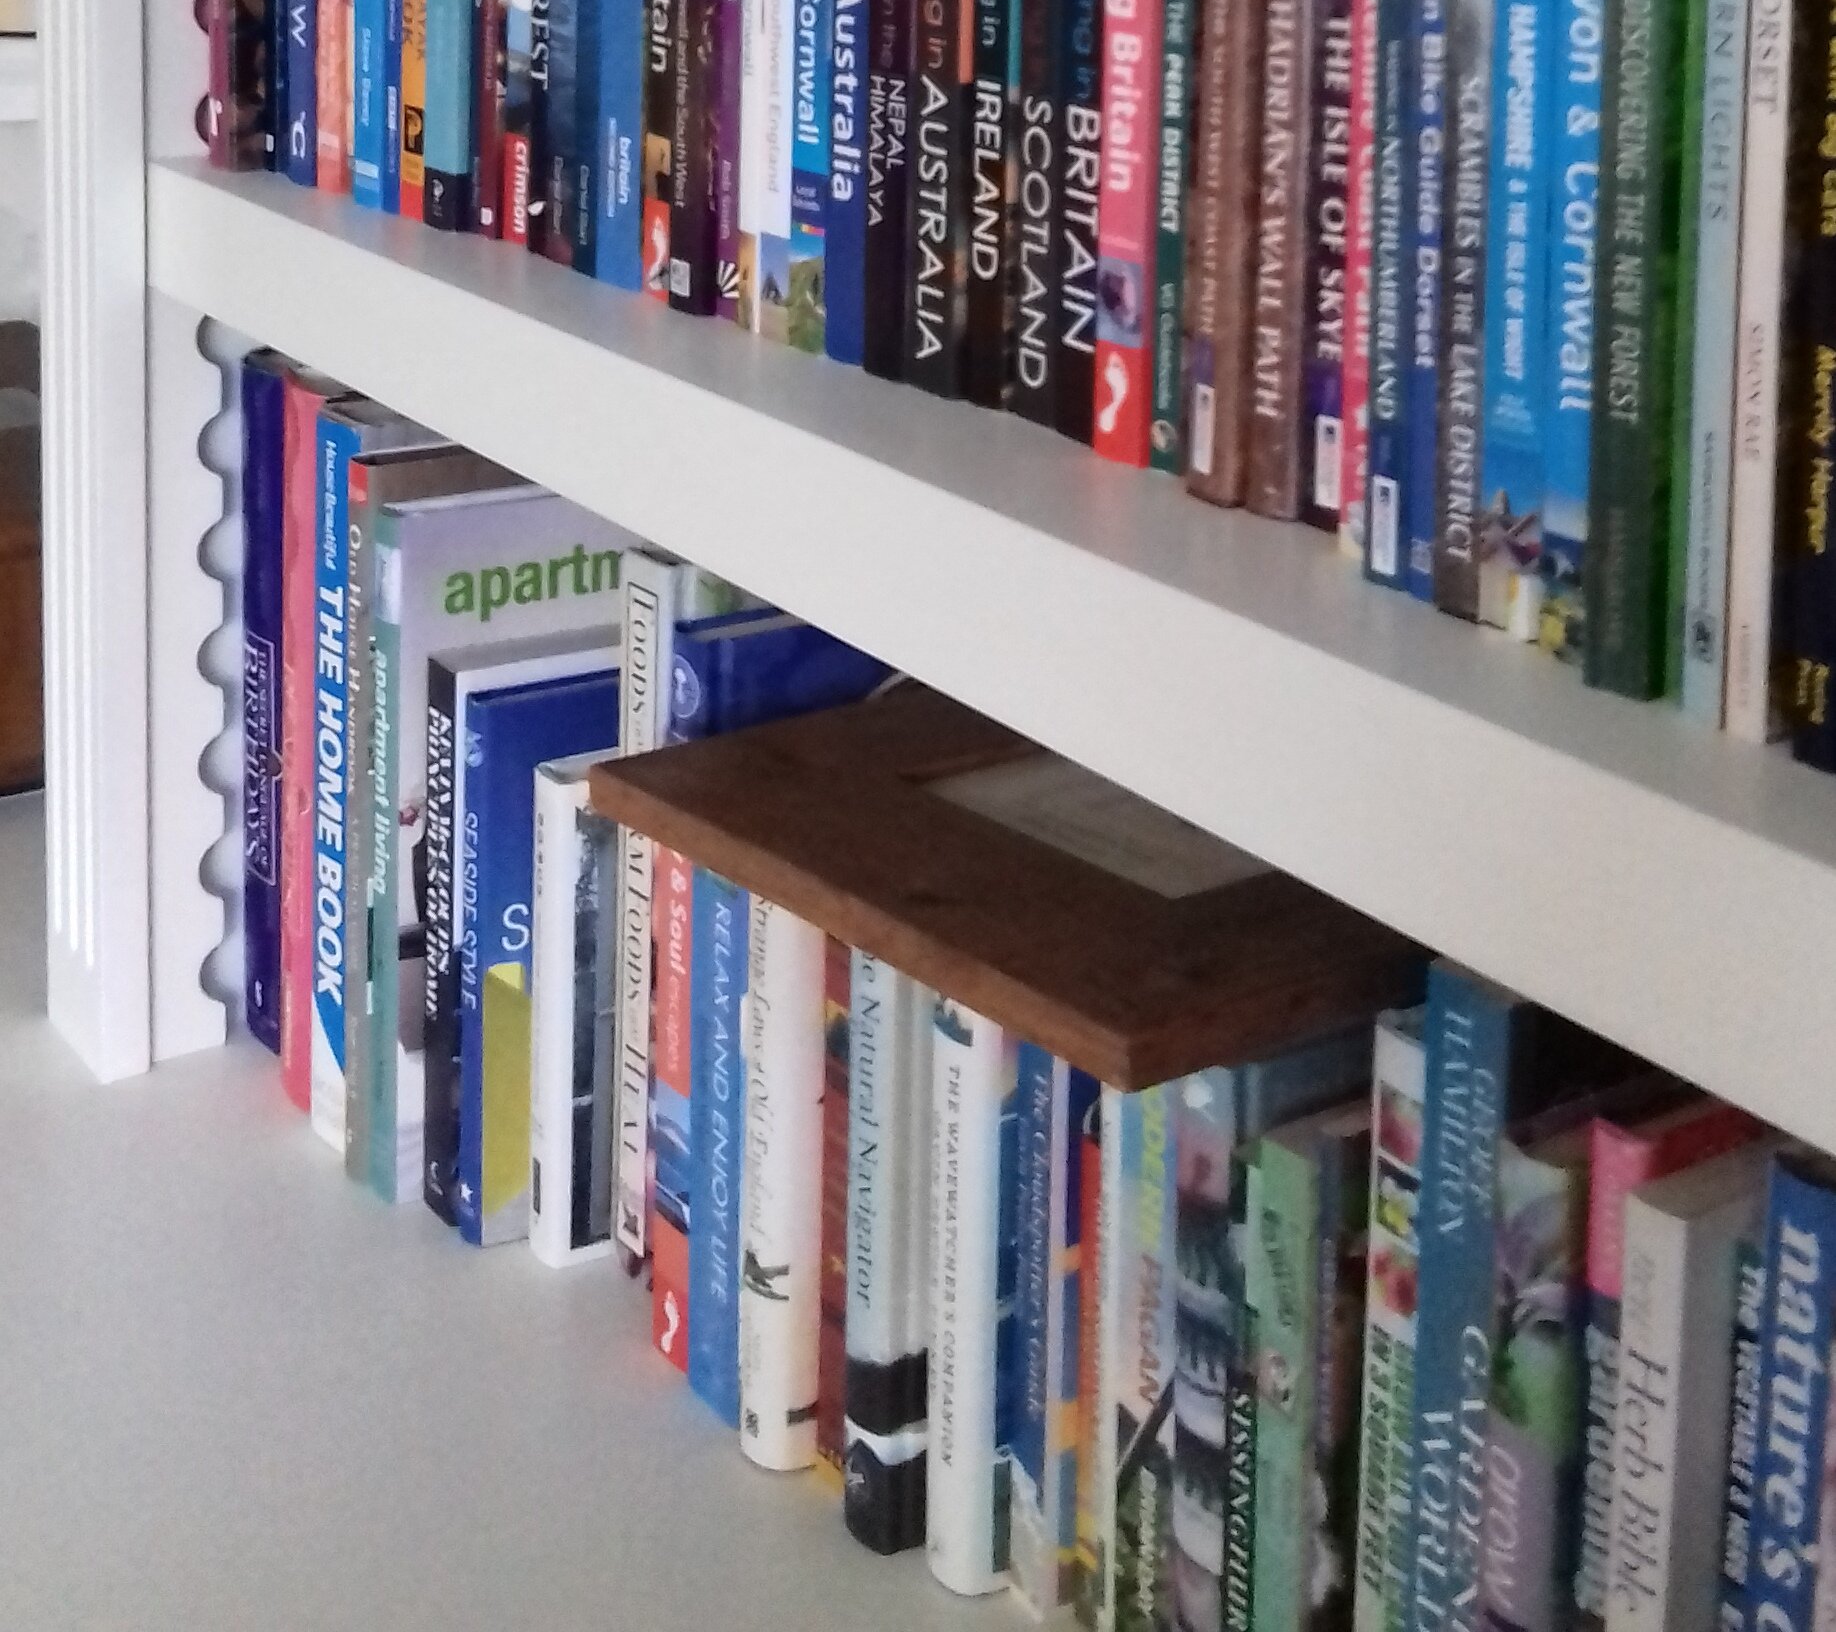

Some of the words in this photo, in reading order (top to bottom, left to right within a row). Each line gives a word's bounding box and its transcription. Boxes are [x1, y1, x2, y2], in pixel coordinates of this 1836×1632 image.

[927, 37, 948, 69] in
[982, 16, 1001, 47] in
[1163, 52, 1185, 117] PEAK
[1323, 17, 1354, 91] THE
[1420, 31, 1448, 115] Bike
[1504, 1, 1540, 170] HAMPSHIRE
[767, 103, 783, 194] England
[867, 74, 889, 227] HIMALAYA
[886, 78, 908, 169] NEPAL
[1106, 32, 1144, 193] Britain
[1262, 0, 1298, 205] HADRIAN'S
[1320, 106, 1353, 184] ISLE
[1566, 104, 1599, 137] &
[1705, 74, 1734, 222] LIGHTS
[513, 140, 529, 235] crimson
[618, 135, 633, 205] britain
[971, 79, 1003, 281] IRELAND
[1159, 126, 1182, 234] DISTRICT
[1418, 126, 1446, 234] Guide
[1454, 71, 1487, 250] SCRAMBLES
[914, 74, 950, 360] AUSTRALIA
[1019, 95, 1054, 389] SCOTLAND
[1061, 103, 1102, 354] BRITAIN
[1258, 215, 1287, 309] WALL
[1319, 196, 1349, 252] OF
[1612, 193, 1645, 245] THE
[1317, 267, 1346, 362] SKYE
[1376, 135, 1403, 422] NORTHUMBERLAND
[1414, 246, 1440, 368] Dorset
[1559, 161, 1601, 411] Cornwall
[1609, 253, 1644, 316] NEW
[1255, 325, 1287, 420] PATH
[1448, 342, 1481, 418] LAKE
[1607, 323, 1641, 426] FOREST
[1445, 424, 1478, 563] DISTRICT
[318, 586, 344, 685] THE
[632, 599, 655, 714] FOODS
[317, 688, 344, 852] HOME
[373, 648, 391, 807] apartment
[373, 811, 391, 895] living
[462, 811, 479, 921] SEASIDE
[669, 866, 688, 895] &
[317, 852, 343, 1007] BOOK
[461, 928, 478, 1010] STYLE
[627, 887, 652, 1000] FOODS
[667, 899, 688, 976] Soul
[712, 900, 733, 1016] RELAX
[711, 1016, 731, 1102] AND
[858, 995, 881, 1128] Natural
[947, 1064, 961, 1111] THE
[1032, 1074, 1050, 1120] The
[710, 1108, 730, 1232] ENJOY
[1440, 1010, 1474, 1233] HAMILTON
[710, 1234, 729, 1305] LIFE
[854, 1135, 880, 1310] Navigator
[940, 1329, 957, 1468] COMPANION
[1625, 1347, 1670, 1480] Herb
[1759, 1219, 1824, 1590] nature's
[1616, 1490, 1661, 1614] Bible
